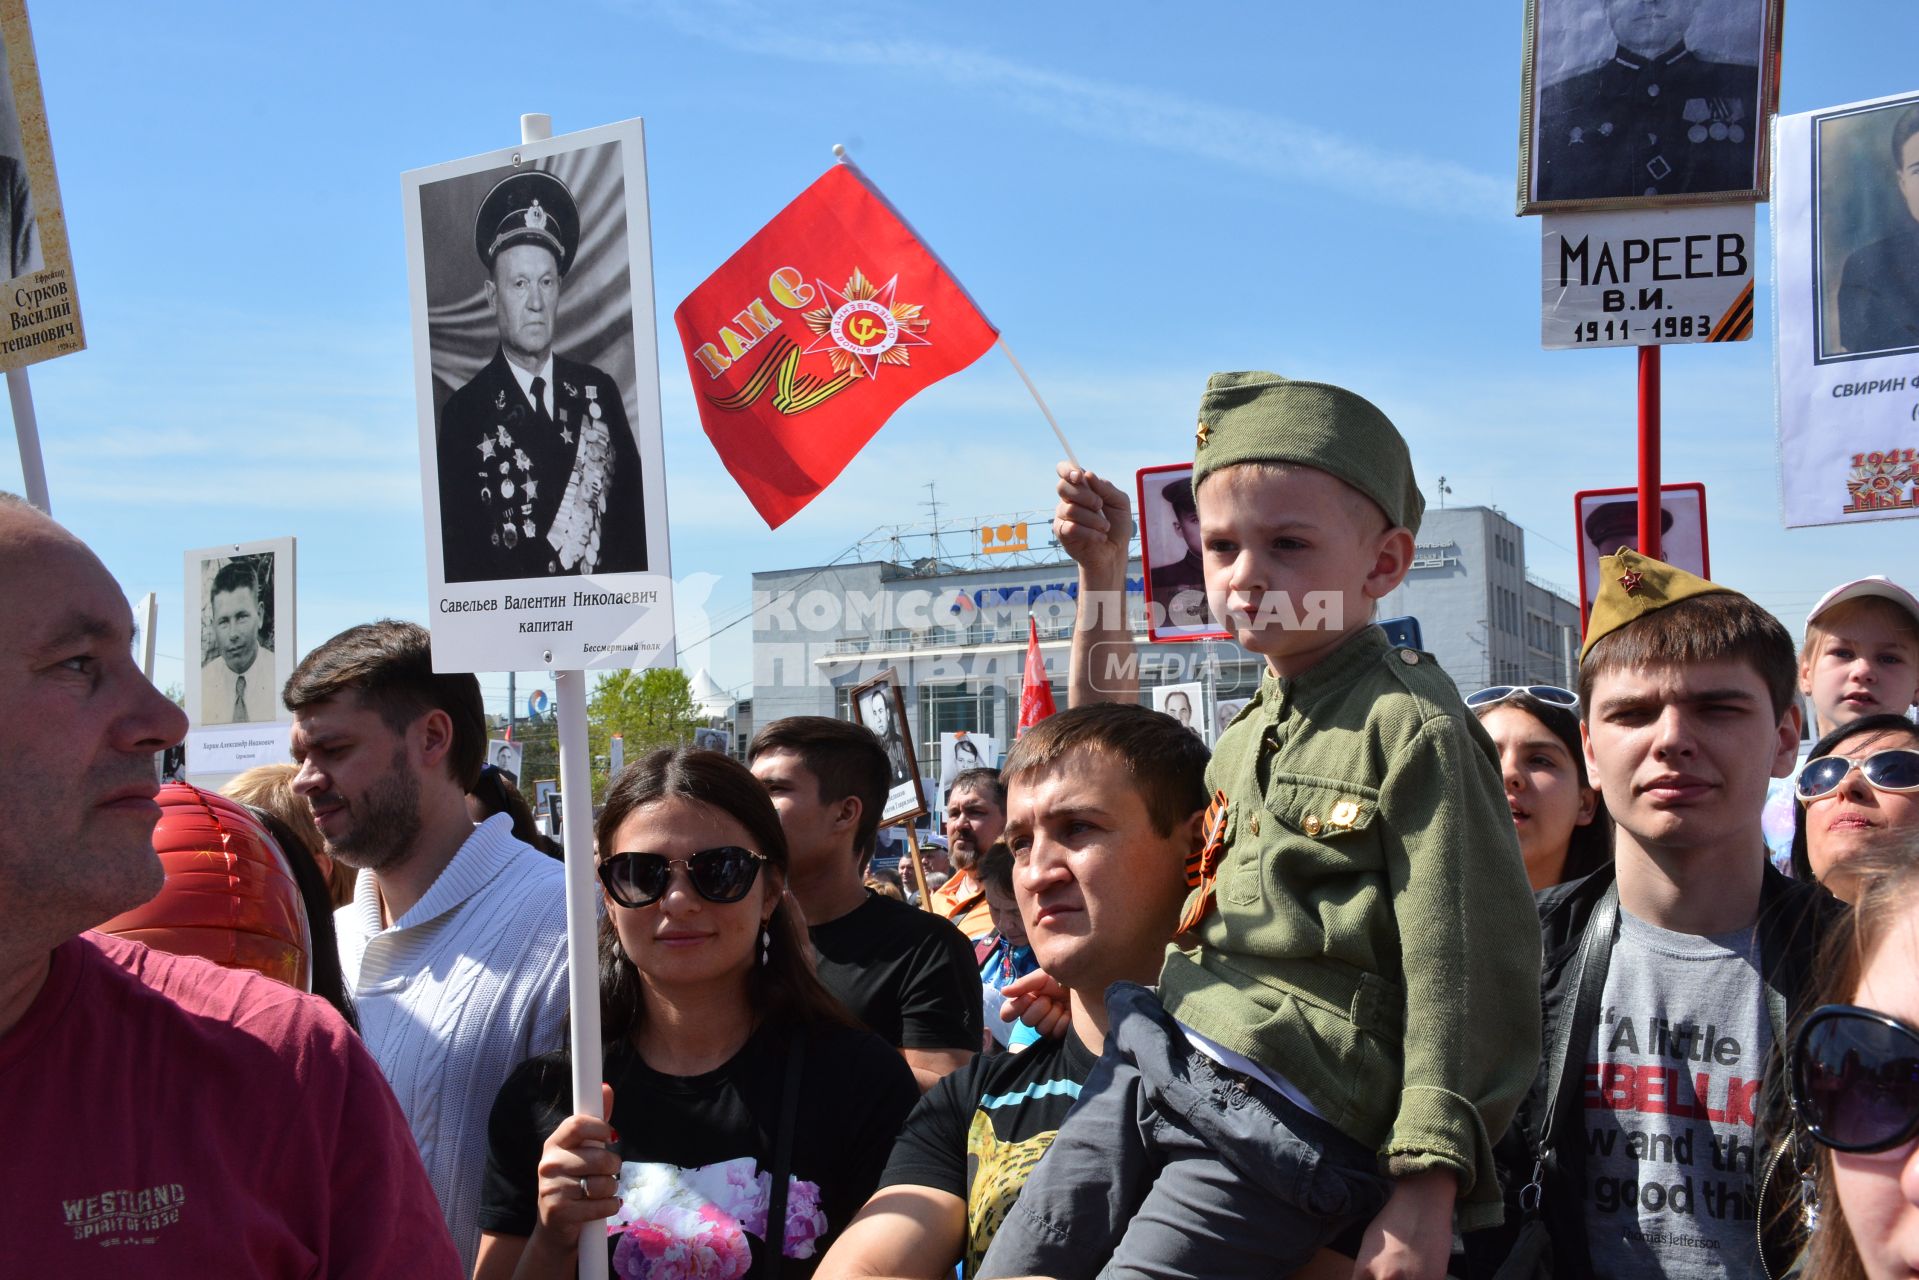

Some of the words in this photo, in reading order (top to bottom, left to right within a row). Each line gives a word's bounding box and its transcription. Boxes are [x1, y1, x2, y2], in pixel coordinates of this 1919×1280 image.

[15, 281, 68, 310] Сурков
[1602, 288, 1673, 312] В.И.
[10, 297, 71, 331] Василий
[0, 322, 75, 355] тепанович
[1832, 376, 1906, 398] СВИРИН
[439, 598, 498, 613] Савельев
[504, 594, 566, 610] Валентин
[573, 590, 658, 607] Николаевич
[518, 620, 573, 633] капитан
[583, 642, 639, 653] Бессмертный
[641, 642, 661, 652] полк
[1648, 1017, 1741, 1066] little
[1625, 1128, 1694, 1166] and
[62, 1184, 186, 1221] WESTLAND
[1595, 1175, 1694, 1215] good
[74, 1217, 125, 1240] SPIRIT
[127, 1217, 139, 1232] OF
[1669, 1231, 1722, 1251] Jefferson
